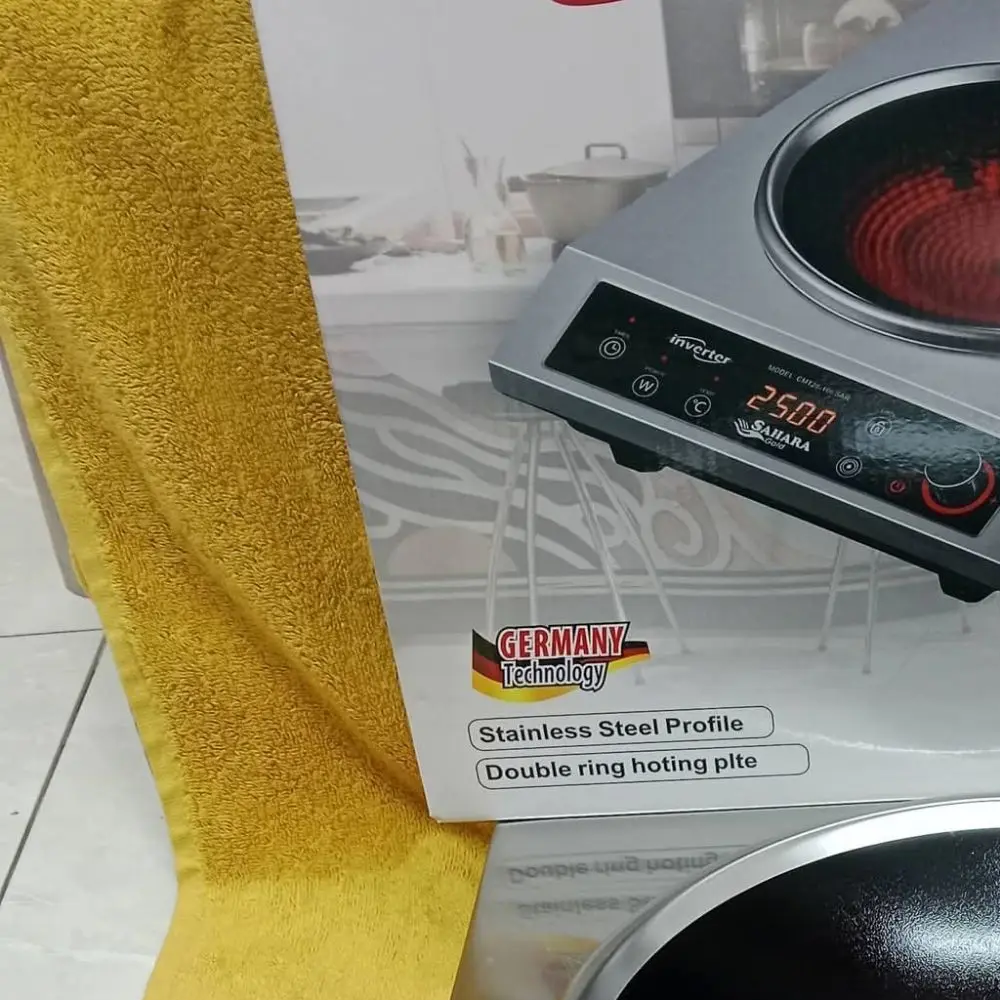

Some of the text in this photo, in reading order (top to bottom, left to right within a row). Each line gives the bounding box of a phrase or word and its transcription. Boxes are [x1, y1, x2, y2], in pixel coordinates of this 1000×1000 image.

[668, 333, 733, 366] inverter
[746, 385, 837, 435] 2500
[751, 419, 811, 453] SAHARA
[764, 437, 787, 451] Gold
[499, 624, 627, 661] GERMANY
[502, 660, 607, 691] Technology
[479, 714, 745, 744] Stainless Steel Profile
[485, 751, 759, 781] Double ring hoting plte
